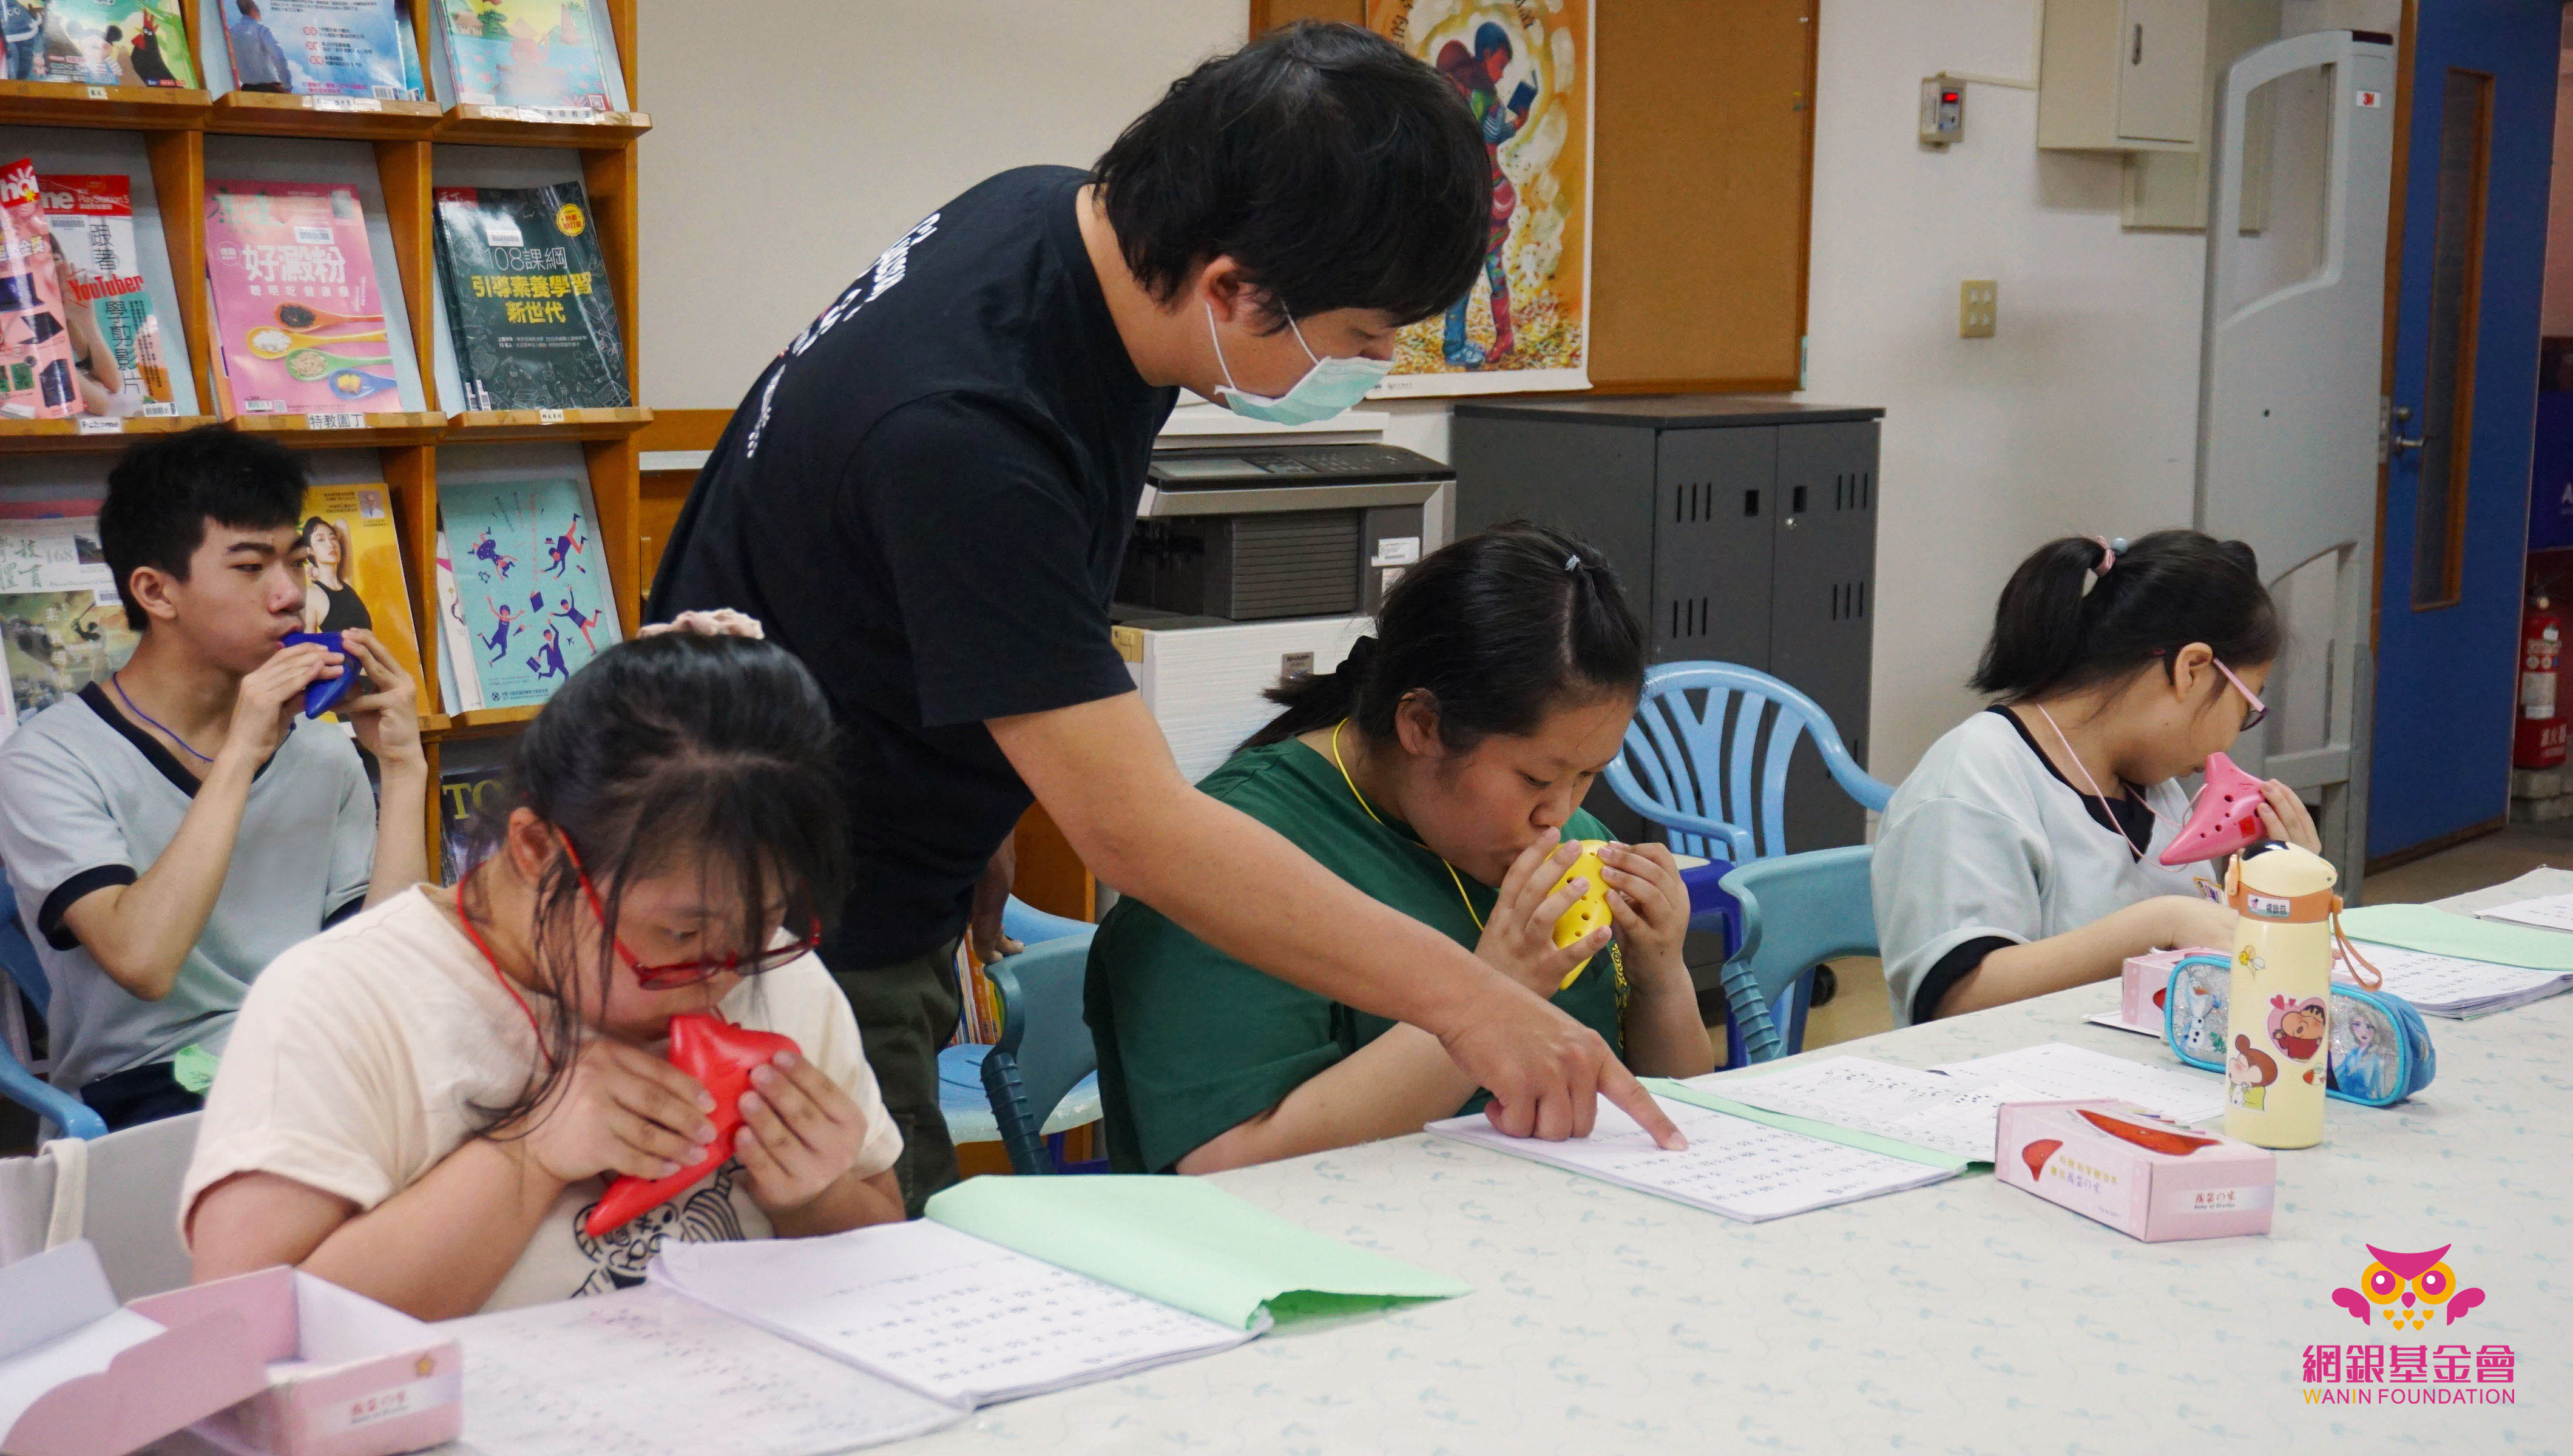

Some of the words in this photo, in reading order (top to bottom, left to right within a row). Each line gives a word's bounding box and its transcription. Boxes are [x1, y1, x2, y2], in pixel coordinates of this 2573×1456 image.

[242, 243, 347, 284] 好澱粉
[484, 246, 569, 271] 108課綱
[68, 274, 144, 302] YouTuber
[470, 271, 593, 298] 引導素養學習
[505, 300, 567, 323] 新世代
[309, 414, 362, 429] 特教園丁
